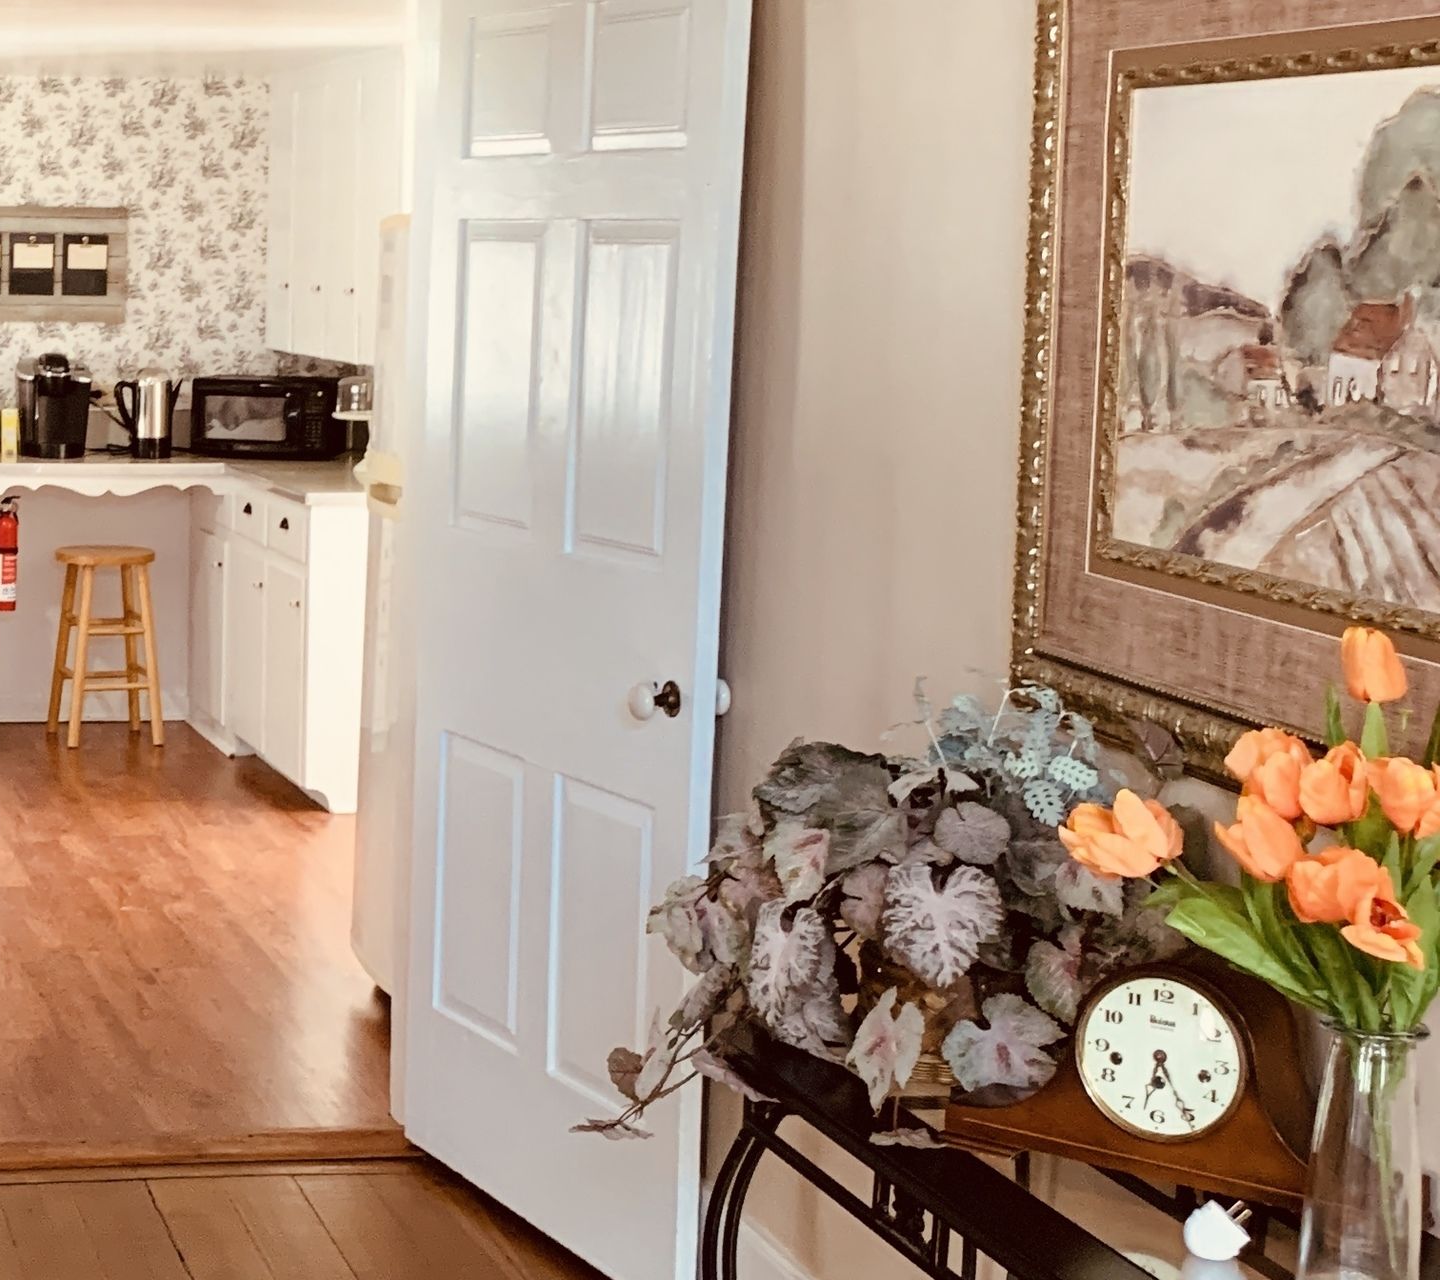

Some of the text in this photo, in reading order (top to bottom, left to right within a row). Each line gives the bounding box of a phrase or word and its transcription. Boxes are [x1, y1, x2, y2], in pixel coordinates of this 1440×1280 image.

[1128, 993, 1141, 1006] 11
[1153, 989, 1174, 1004] 12
[1192, 1003, 1198, 1015] 1
[1105, 1010, 1122, 1024] 10
[1095, 1039, 1109, 1052] 9
[1101, 1068, 1116, 1082] 8
[1215, 1060, 1229, 1076] 3
[1121, 1095, 1135, 1109] 7
[1203, 1090, 1218, 1103] 4
[1150, 1110, 1165, 1124] 6
